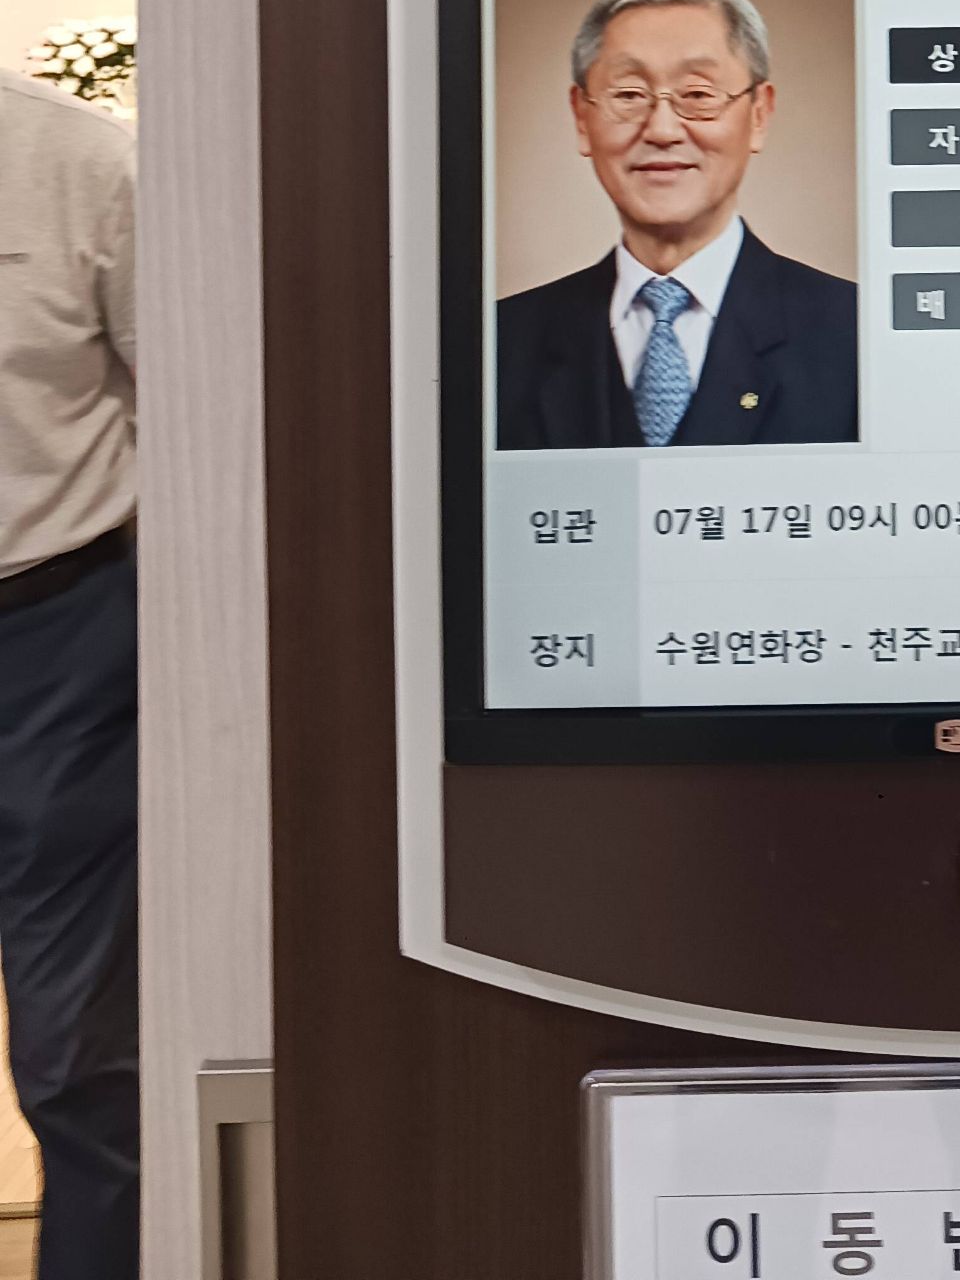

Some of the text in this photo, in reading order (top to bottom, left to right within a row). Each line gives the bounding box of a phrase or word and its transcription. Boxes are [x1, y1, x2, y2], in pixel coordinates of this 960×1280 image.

[529, 508, 598, 544] 입관
[654, 505, 725, 541] 07월
[741, 503, 812, 539] 17일
[827, 502, 897, 537] 09시
[530, 633, 594, 668] 장지
[655, 628, 828, 666] 수원연화장
